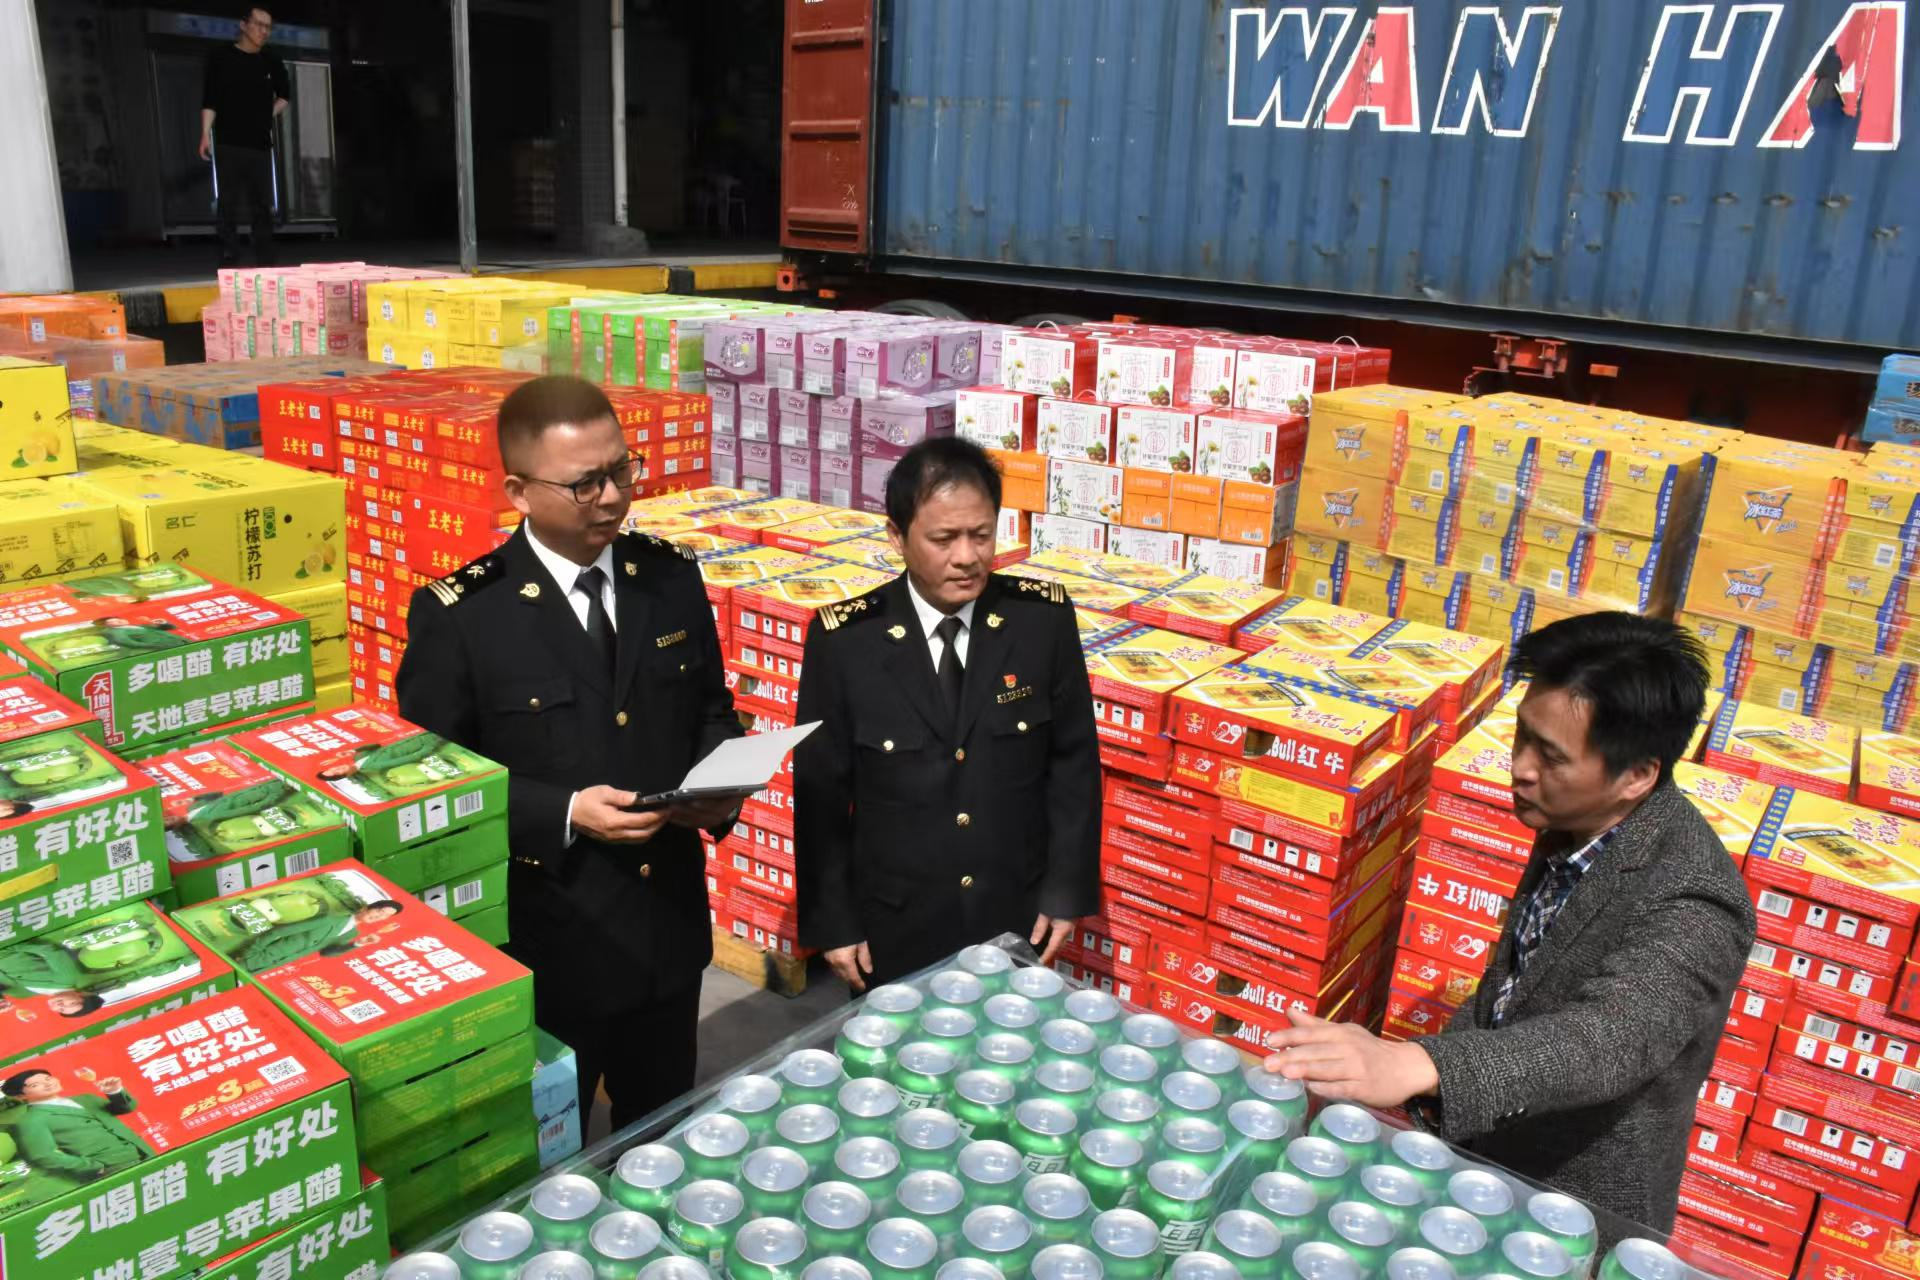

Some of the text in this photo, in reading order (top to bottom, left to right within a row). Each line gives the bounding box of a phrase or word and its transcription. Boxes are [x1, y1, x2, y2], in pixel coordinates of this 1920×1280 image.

[1228, 5, 1563, 137] WAN
[166, 514, 196, 539] 名仁
[244, 508, 262, 591] 柠檬苏打
[428, 510, 465, 536] 王老吉
[128, 629, 301, 693] 多喝醋 有好处
[131, 674, 303, 740] 天地壹号苹果醋
[1297, 744, 1345, 774] 红牛
[34, 797, 149, 861] 有好处
[1418, 873, 1468, 905] 红牛
[366, 946, 449, 996] 有好处
[401, 935, 487, 983] 多喝醋
[127, 1006, 249, 1063] 多喝醋
[139, 1025, 266, 1082] 有好处
[153, 1042, 277, 1096] 天地壹号苹果醋
[35, 1161, 188, 1260] 多喝醋
[206, 1100, 338, 1185] 有好处
[255, 1202, 373, 1280] 有好处
